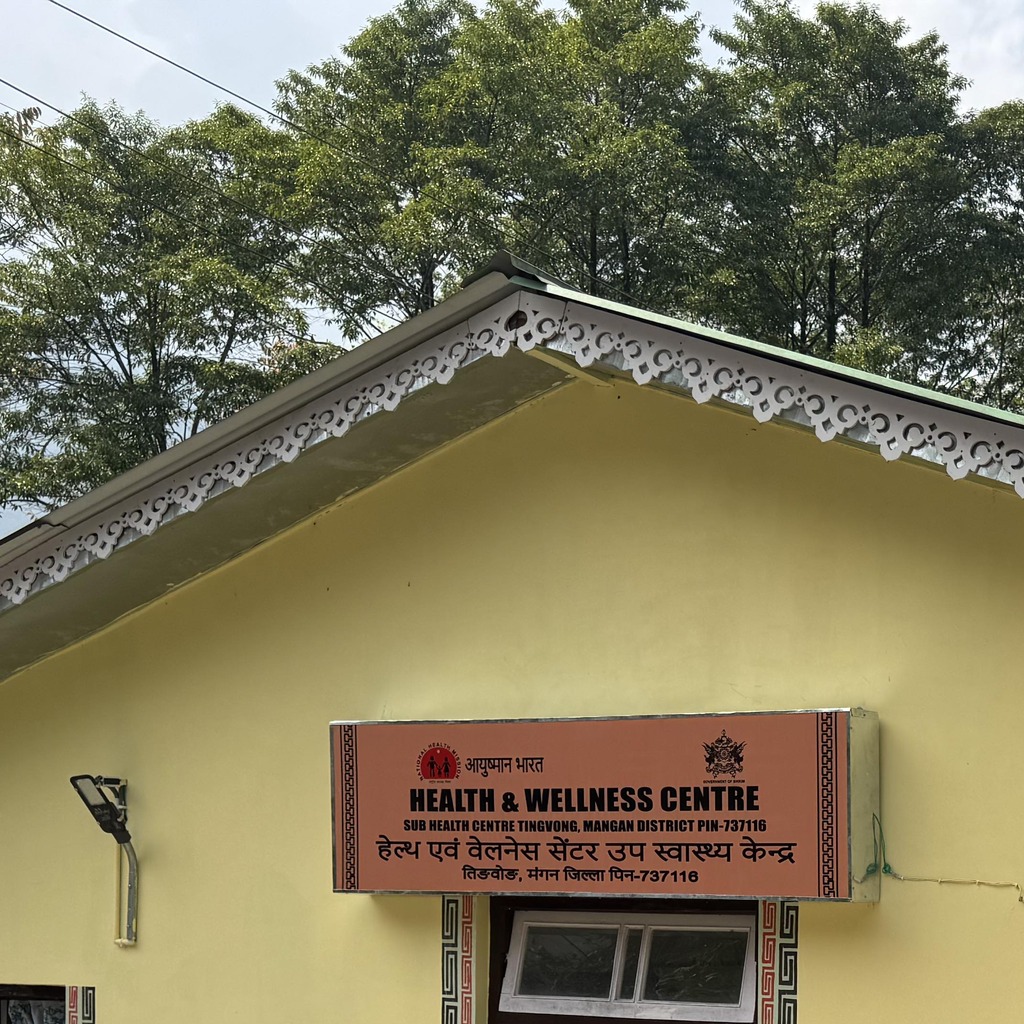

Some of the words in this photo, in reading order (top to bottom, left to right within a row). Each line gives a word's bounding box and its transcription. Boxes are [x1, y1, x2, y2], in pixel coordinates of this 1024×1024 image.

[416, 748, 428, 781] NATIONAL
[428, 742, 451, 751] HEALTH
[450, 748, 462, 779] MISSION
[465, 757, 512, 777] आयुष्मान
[516, 757, 544, 774] भारत
[410, 788, 495, 812] HEALTH
[501, 792, 519, 812] &
[524, 787, 653, 812] WELLNESS
[660, 786, 759, 811] CENTRE
[404, 819, 426, 831] SUB
[429, 820, 469, 831] HEALTH
[472, 820, 515, 832] CENTRE
[517, 820, 580, 833] TINGVONG,
[583, 820, 634, 832] MANGAN
[637, 820, 695, 832] DISTRICT
[698, 819, 767, 832] PIN-737116
[376, 834, 421, 861] हेल्थ
[427, 838, 460, 862] एवं
[466, 836, 541, 861] वेलनेस
[546, 836, 600, 861] सेंटर
[605, 842, 646, 862] उप
[652, 842, 733, 862] स्वास्थ्य
[739, 836, 797, 863] केन्द्र
[527, 866, 560, 881] मंगन
[563, 866, 605, 882] जिल्ला
[608, 866, 699, 882] पिन-737116
